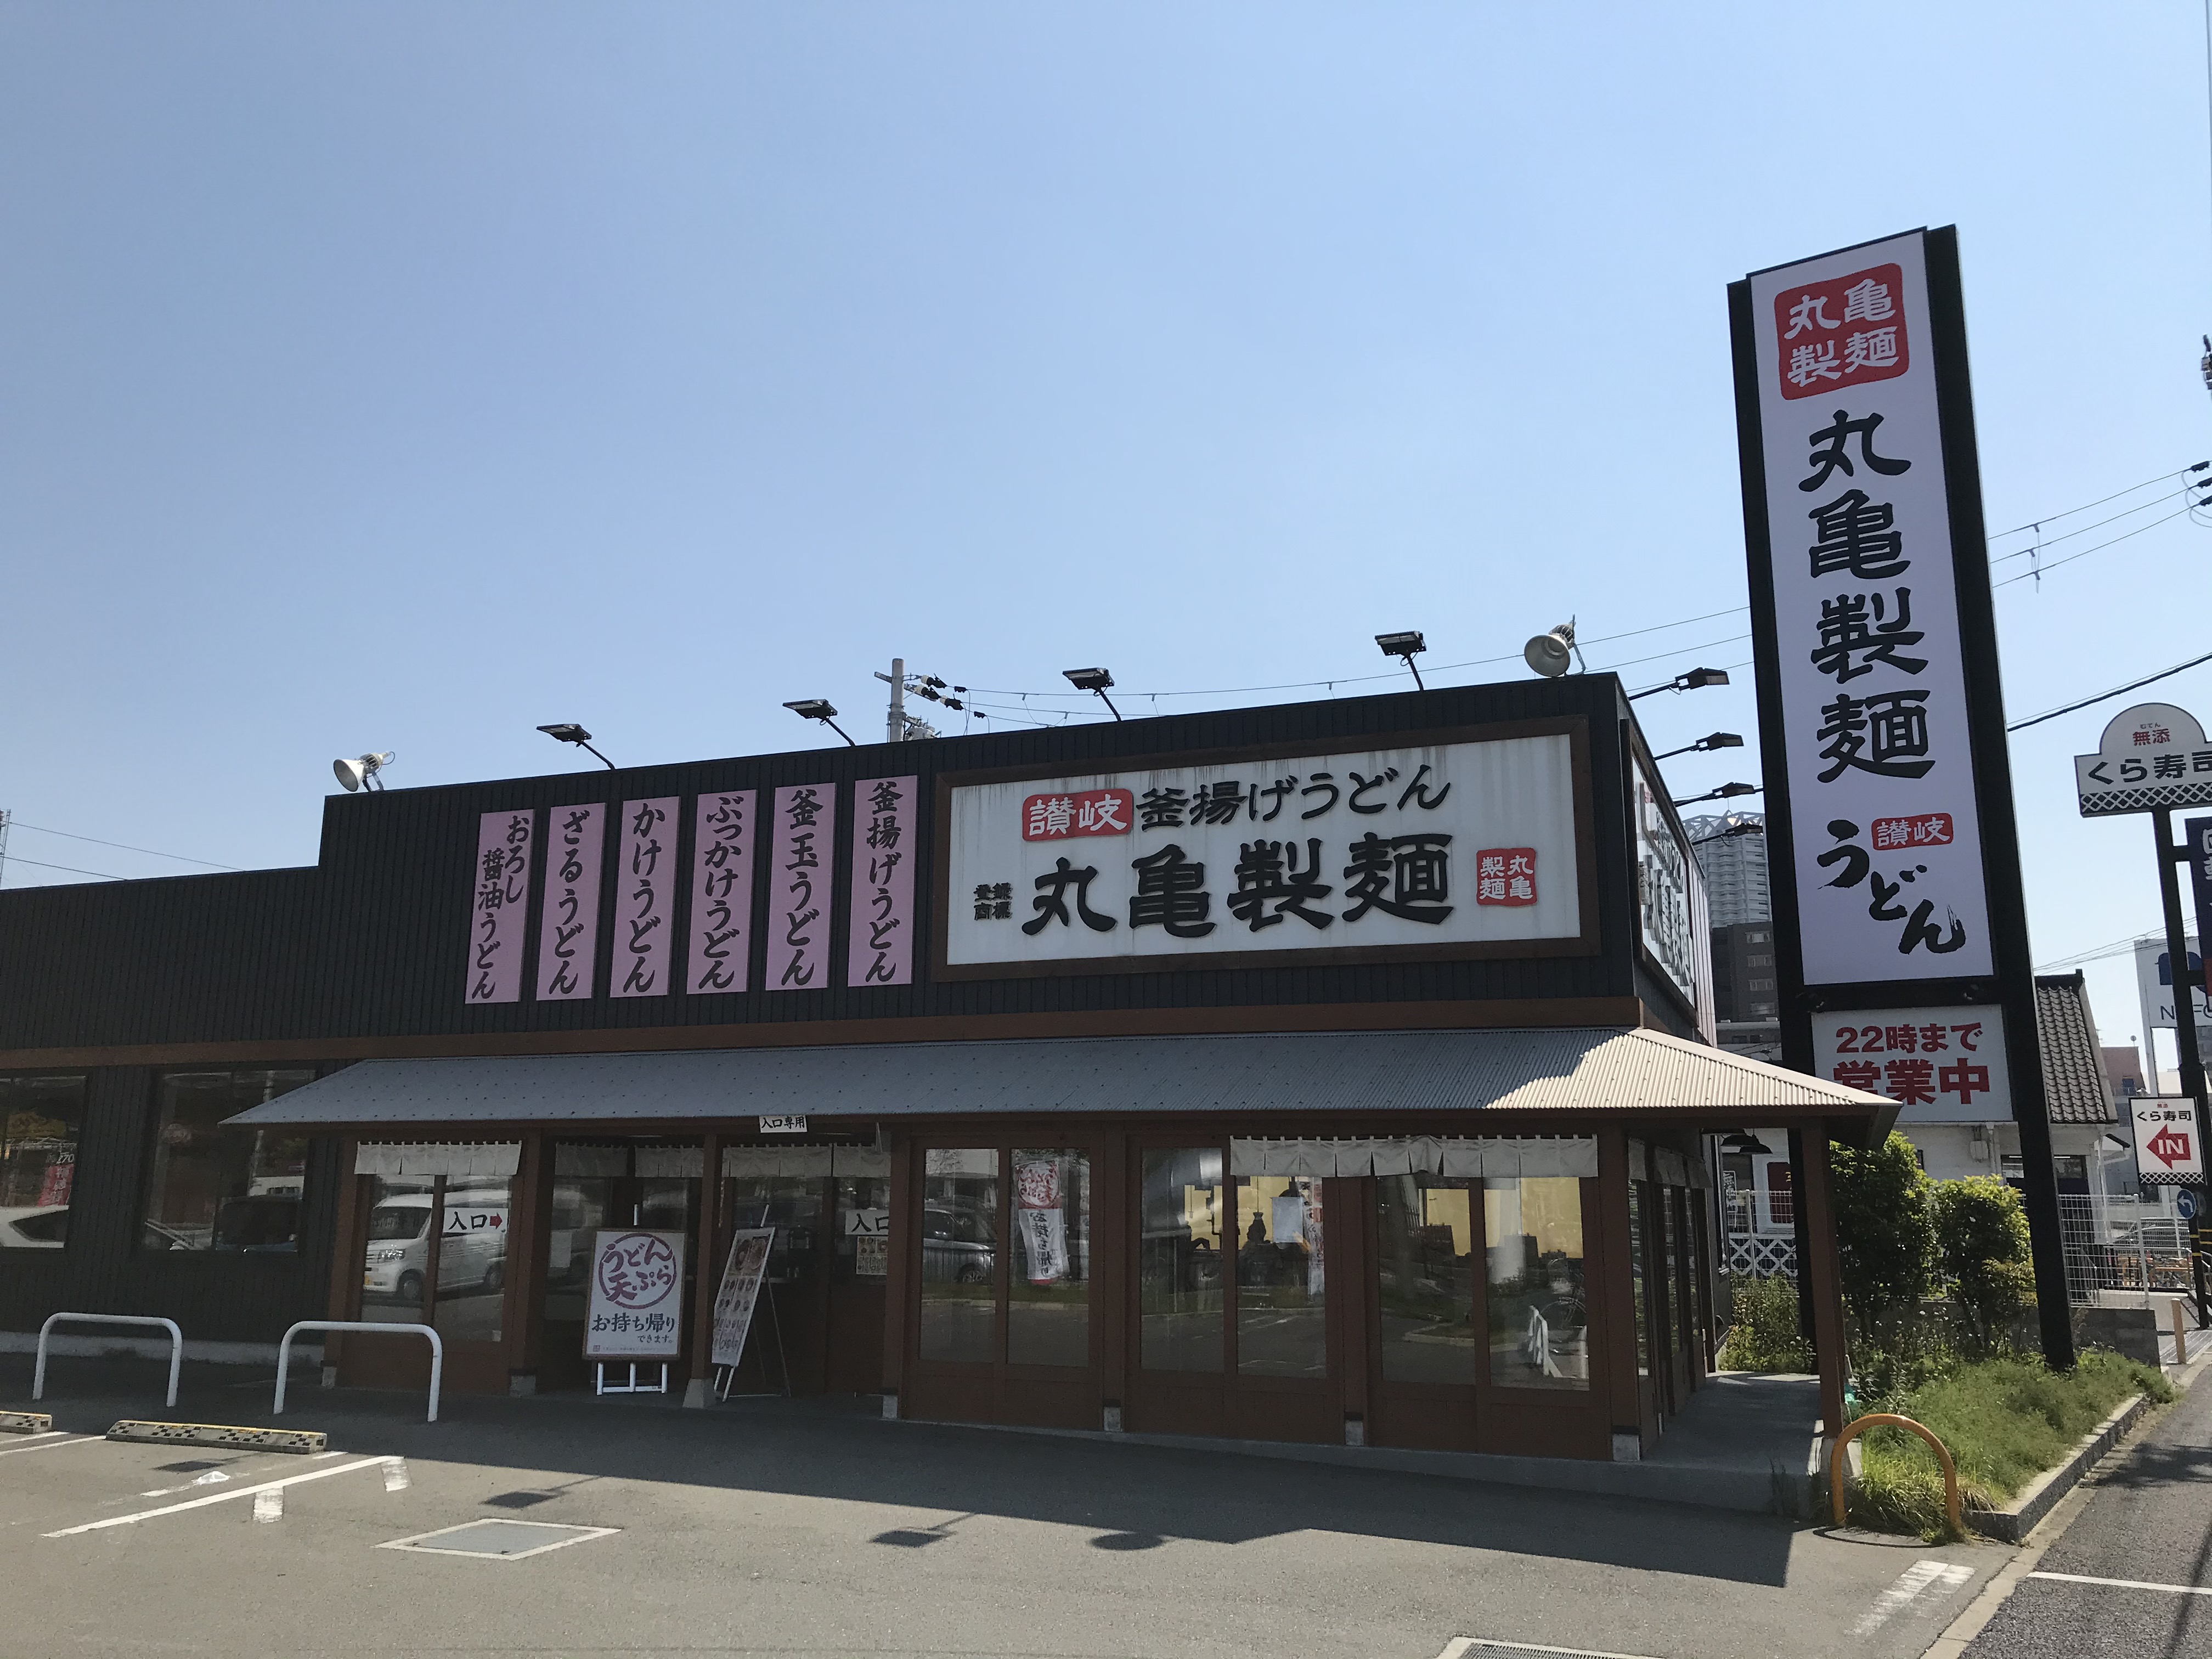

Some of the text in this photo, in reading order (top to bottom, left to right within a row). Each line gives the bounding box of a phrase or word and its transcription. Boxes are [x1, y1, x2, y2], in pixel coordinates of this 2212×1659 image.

[1784, 278, 1897, 340] 丸亀
[1787, 326, 1900, 387] 製麺
[1798, 410, 1936, 783] 丸亀製麺
[2132, 728, 2171, 746] 無添
[1029, 763, 1451, 836] 讃岐 釜揚げうどん
[1876, 816, 1950, 847] 讃岐
[504, 815, 529, 904] おろし
[865, 781, 904, 984] 釜揚げうどん
[1507, 855, 1534, 899] 丸亀
[548, 809, 591, 996] ざるうどん
[622, 803, 665, 994] かけうどん
[698, 795, 743, 990] ぶっかけうどん
[781, 789, 823, 986] 釜玉うどん
[1022, 831, 1454, 938] 丸亀製麺
[1817, 820, 1966, 955] うどん
[1836, 1022, 1982, 1054] 22時まで
[1833, 1058, 1990, 1105] 営業中
[761, 1115, 805, 1130] 入口専用
[2137, 1110, 2192, 1121] くら寿司
[2158, 1139, 2184, 1154] IN
[449, 1211, 488, 1231] 入口
[851, 1213, 889, 1232] 入口
[603, 1237, 673, 1273] うどん
[605, 1265, 673, 1302] 天ぷら
[591, 1312, 675, 1333] お持ち帰り
